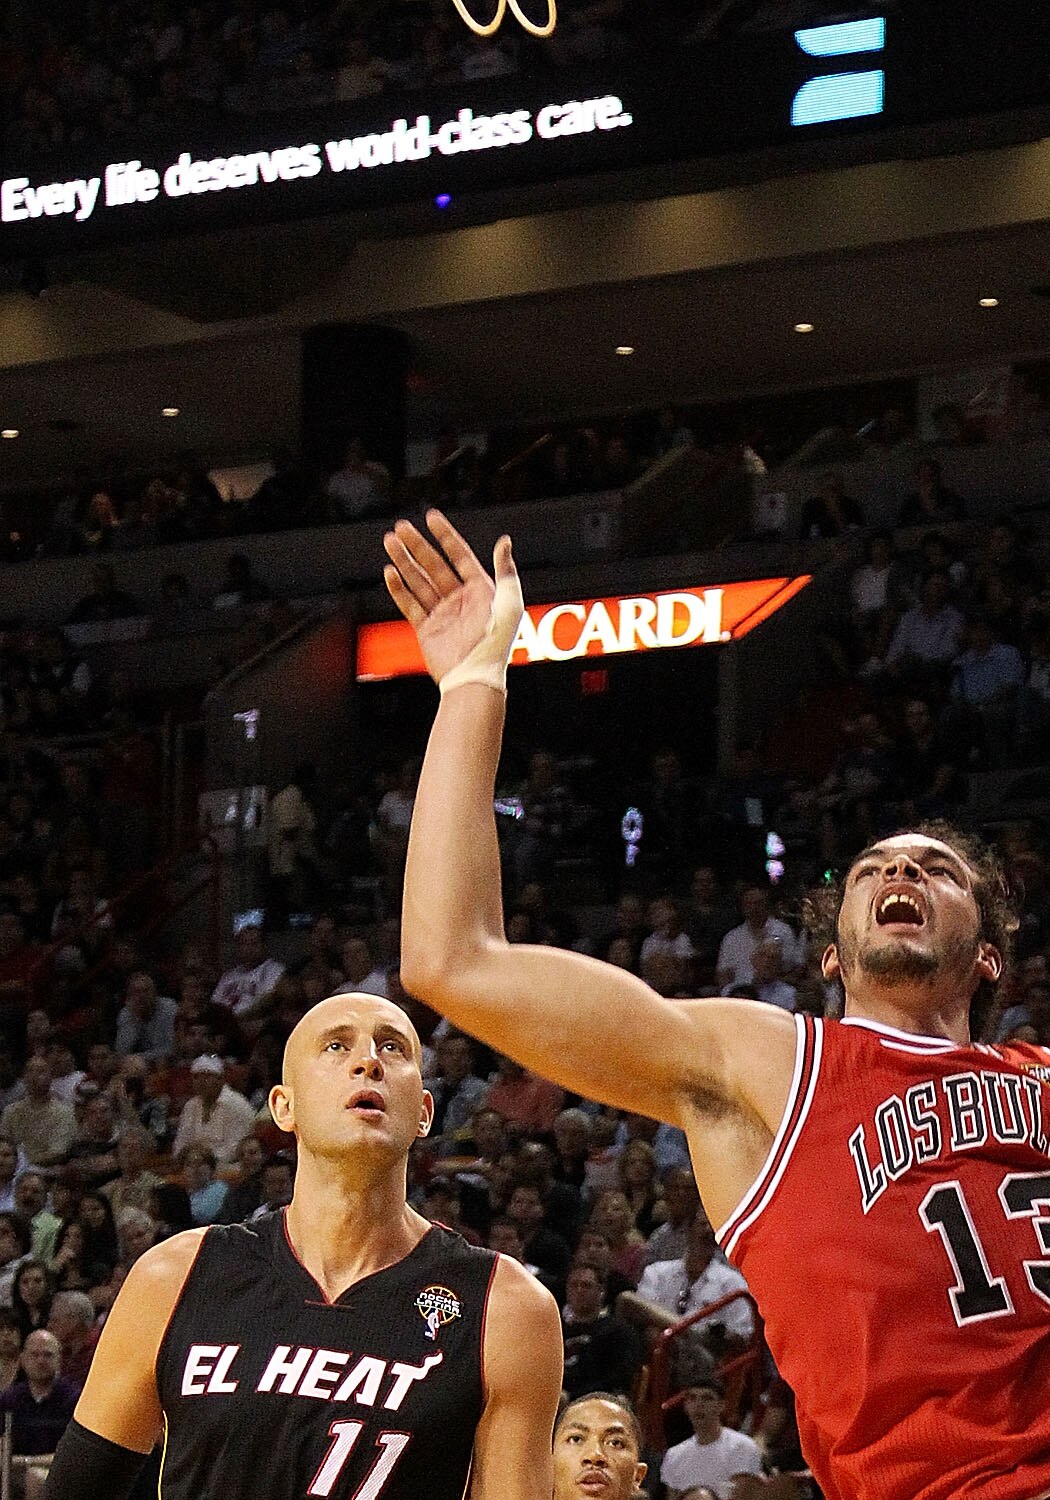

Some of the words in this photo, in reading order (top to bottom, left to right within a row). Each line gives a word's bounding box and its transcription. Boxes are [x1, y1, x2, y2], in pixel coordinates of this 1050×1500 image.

[1, 177, 100, 222] Every
[104, 159, 160, 206] life
[163, 152, 322, 197] deserves
[325, 108, 533, 173] world-class
[536, 95, 633, 139] care.
[508, 589, 724, 663] ACARDI
[849, 1080, 942, 1215] LOS
[180, 1343, 241, 1398] EL
[256, 1343, 443, 1411] HEAT
